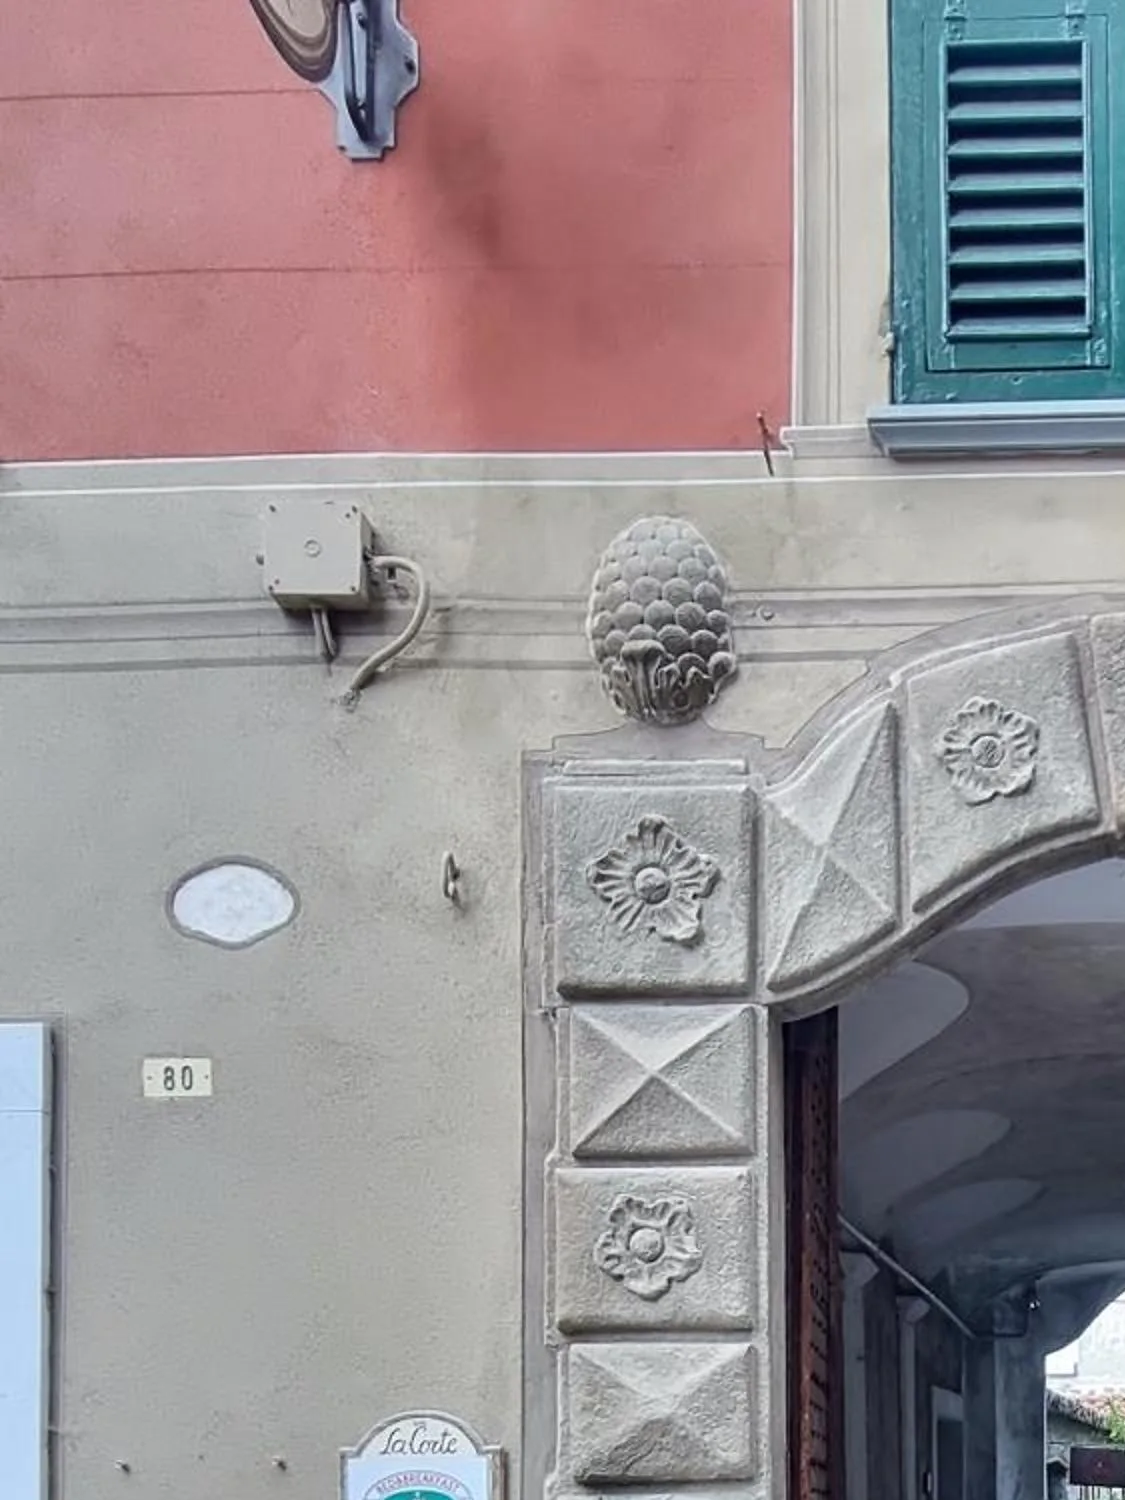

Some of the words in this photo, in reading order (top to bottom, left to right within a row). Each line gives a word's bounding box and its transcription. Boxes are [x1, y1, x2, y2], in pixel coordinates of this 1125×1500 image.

[163, 1065, 193, 1091] 80
[380, 1427, 408, 1456] La
[409, 1421, 457, 1456] Corte
